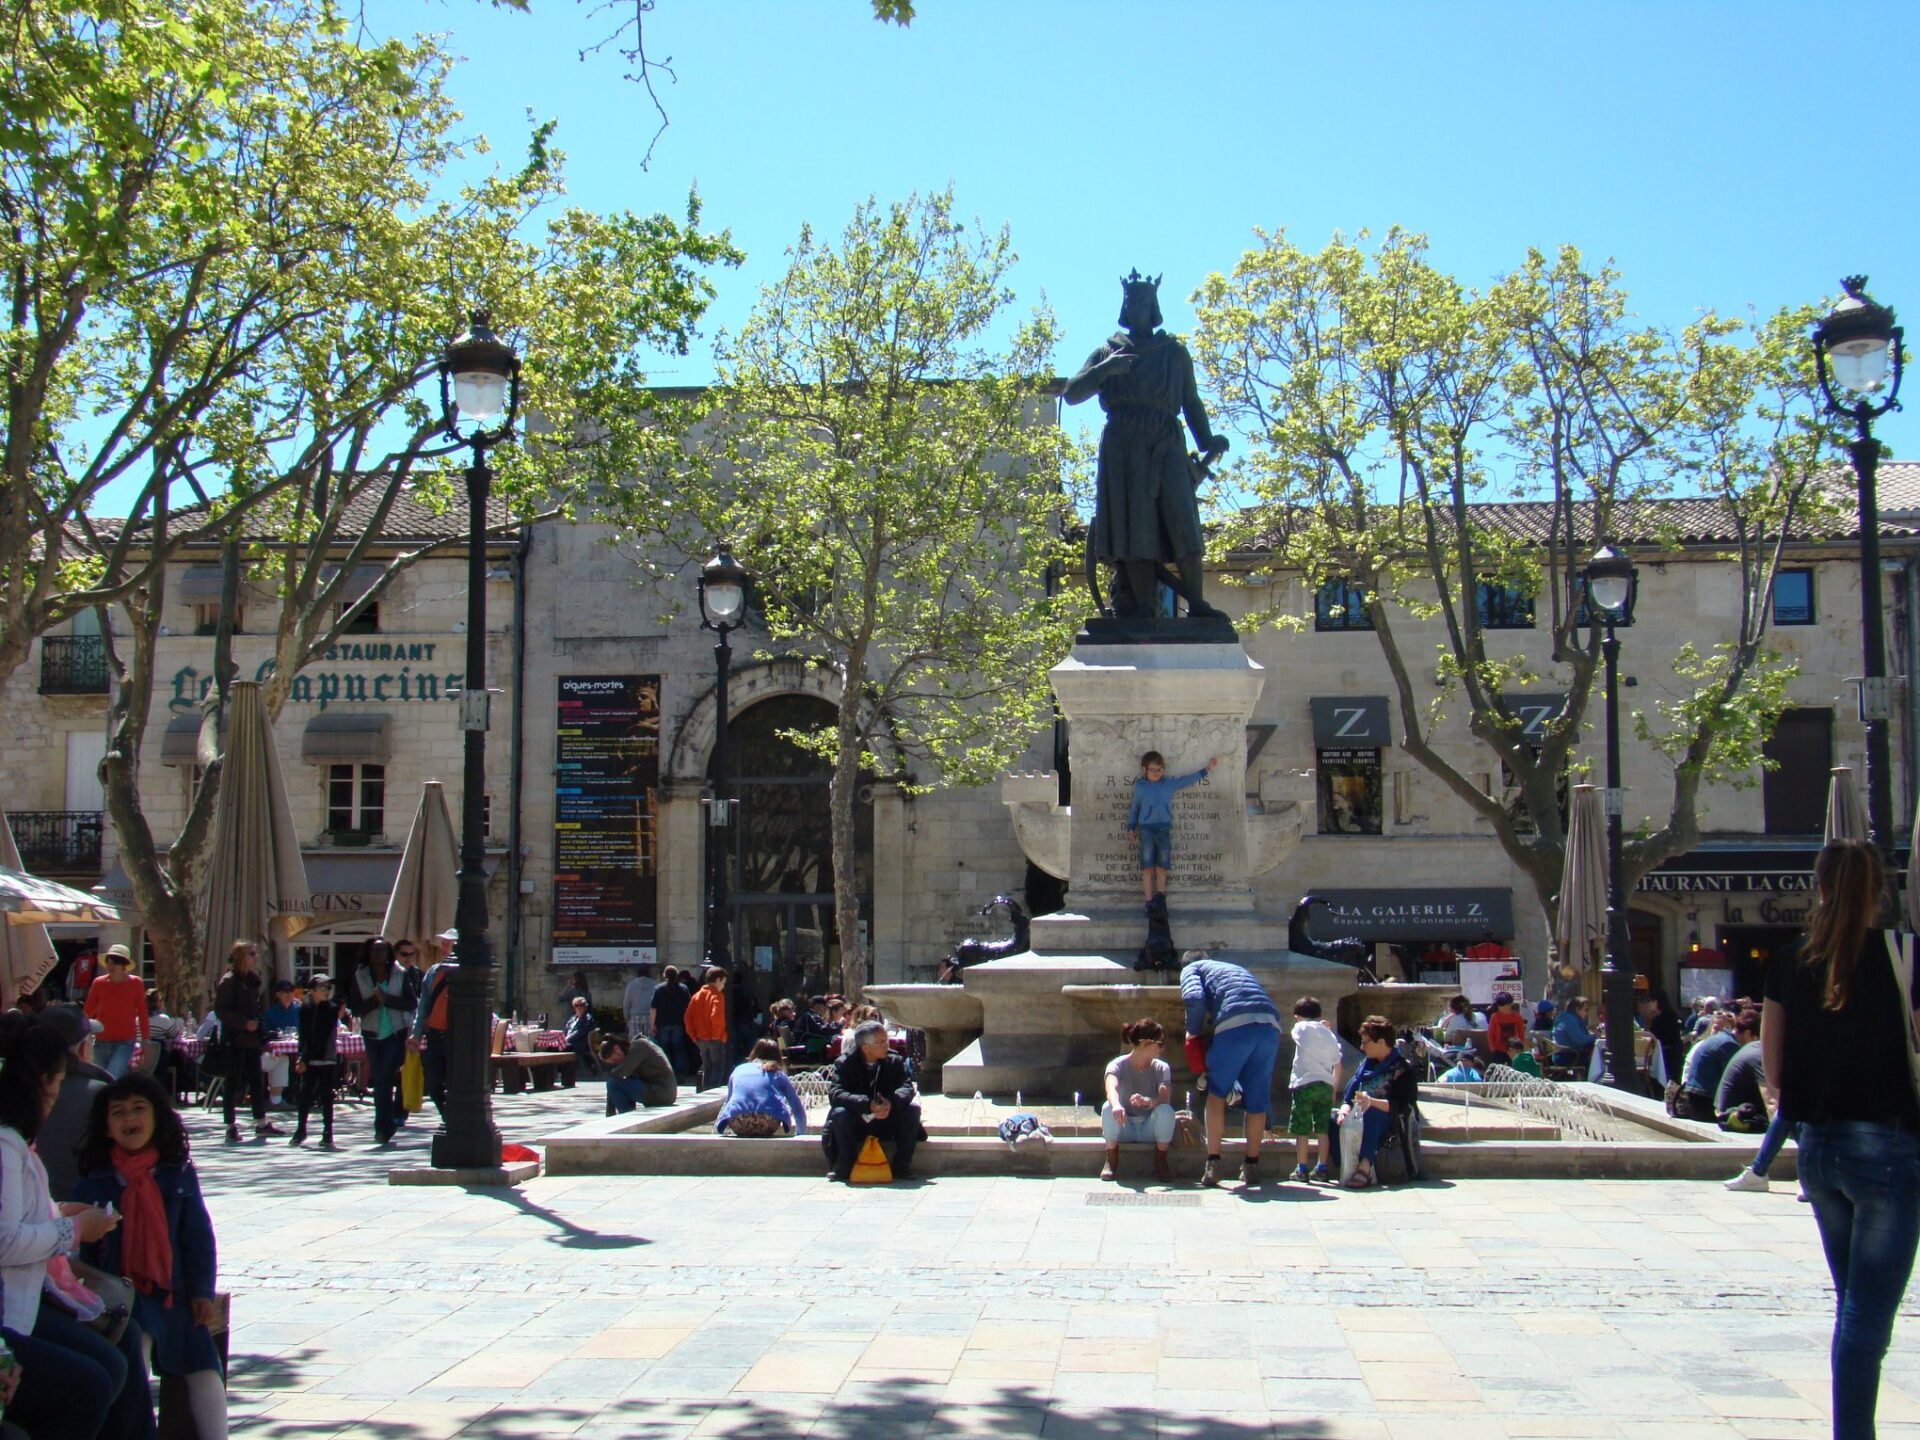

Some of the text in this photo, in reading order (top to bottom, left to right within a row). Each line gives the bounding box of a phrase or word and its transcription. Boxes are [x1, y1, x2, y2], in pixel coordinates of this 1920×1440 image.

[325, 643, 436, 661] STAURANT
[1333, 708, 1370, 737] Z
[1519, 706, 1553, 735] Z
[1114, 791, 1134, 800] VILL
[1178, 812, 1221, 821] SOUVENIR
[1179, 832, 1211, 841] STATUE
[1095, 853, 1127, 861] TEMOIN
[1170, 853, 1223, 862] ARQUEMENT
[1181, 873, 1225, 882] CROISADE
[1747, 876, 1773, 890] LA
[1338, 903, 1482, 916] LA GALERIE Z
[1723, 897, 1744, 923] la
[1379, 917, 1405, 925] d'Art
[1412, 917, 1489, 925] Contemporain
